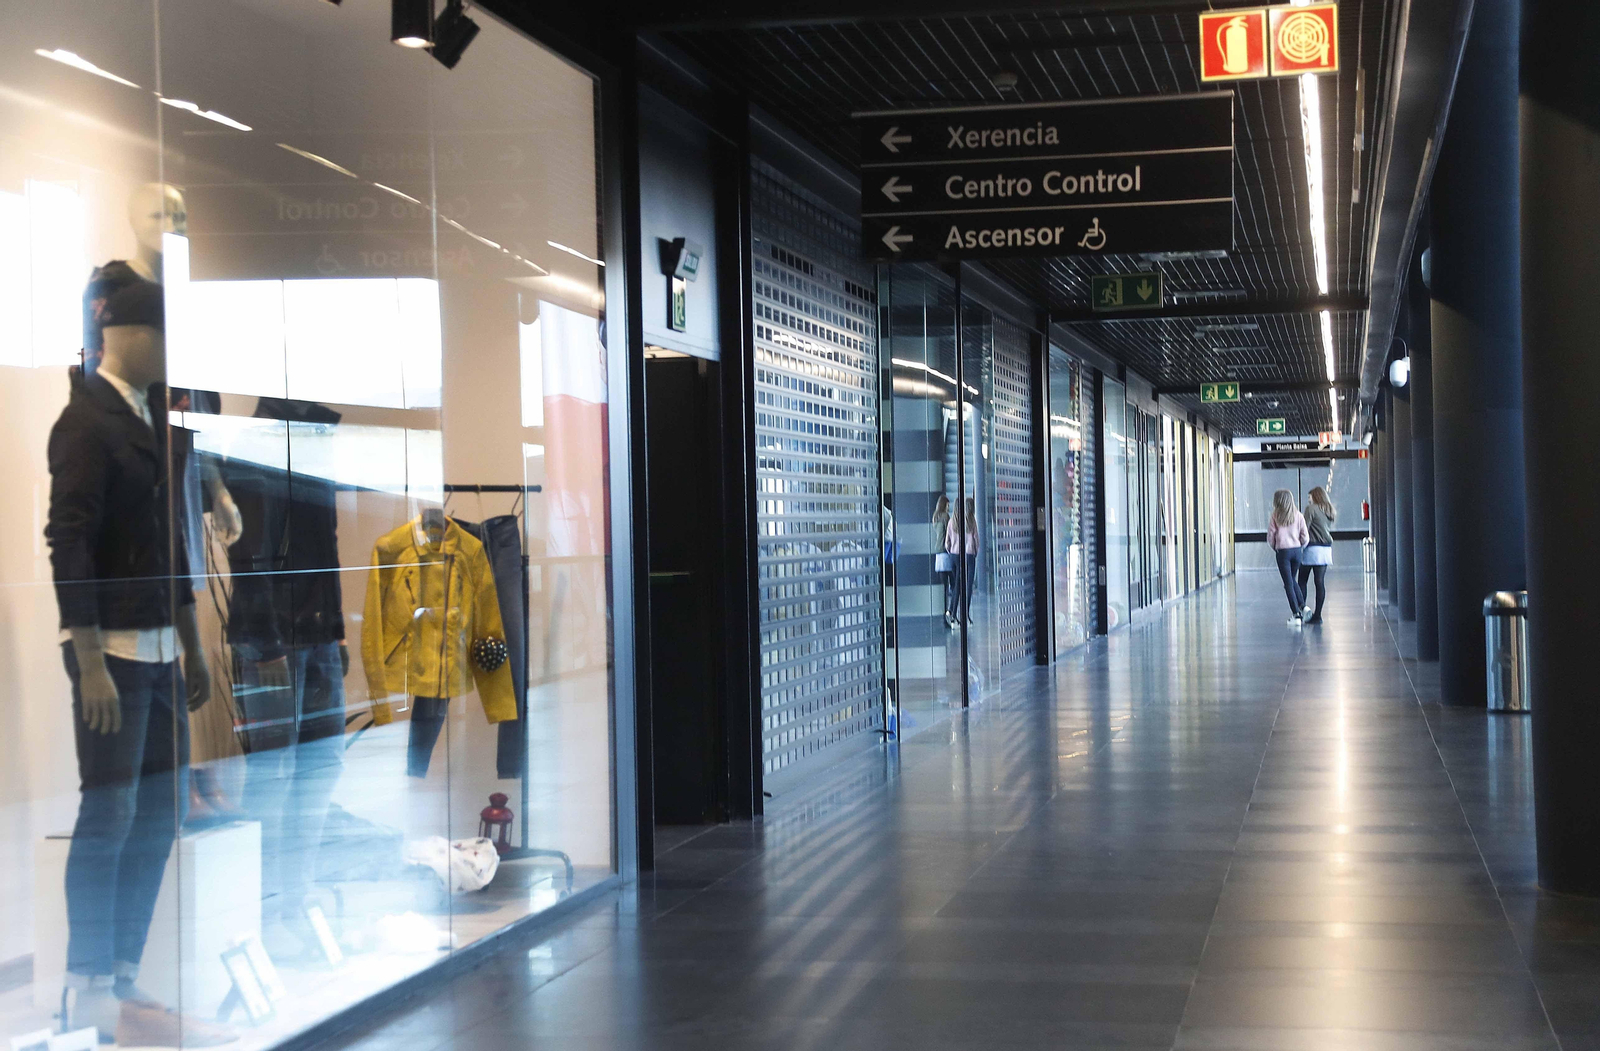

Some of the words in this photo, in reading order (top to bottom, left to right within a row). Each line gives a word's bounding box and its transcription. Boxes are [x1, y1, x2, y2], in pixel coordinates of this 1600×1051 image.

[948, 122, 1059, 148] Xerencia
[945, 174, 1032, 199] Centro
[1043, 165, 1141, 195] Control
[945, 226, 1065, 249] Ascensor
